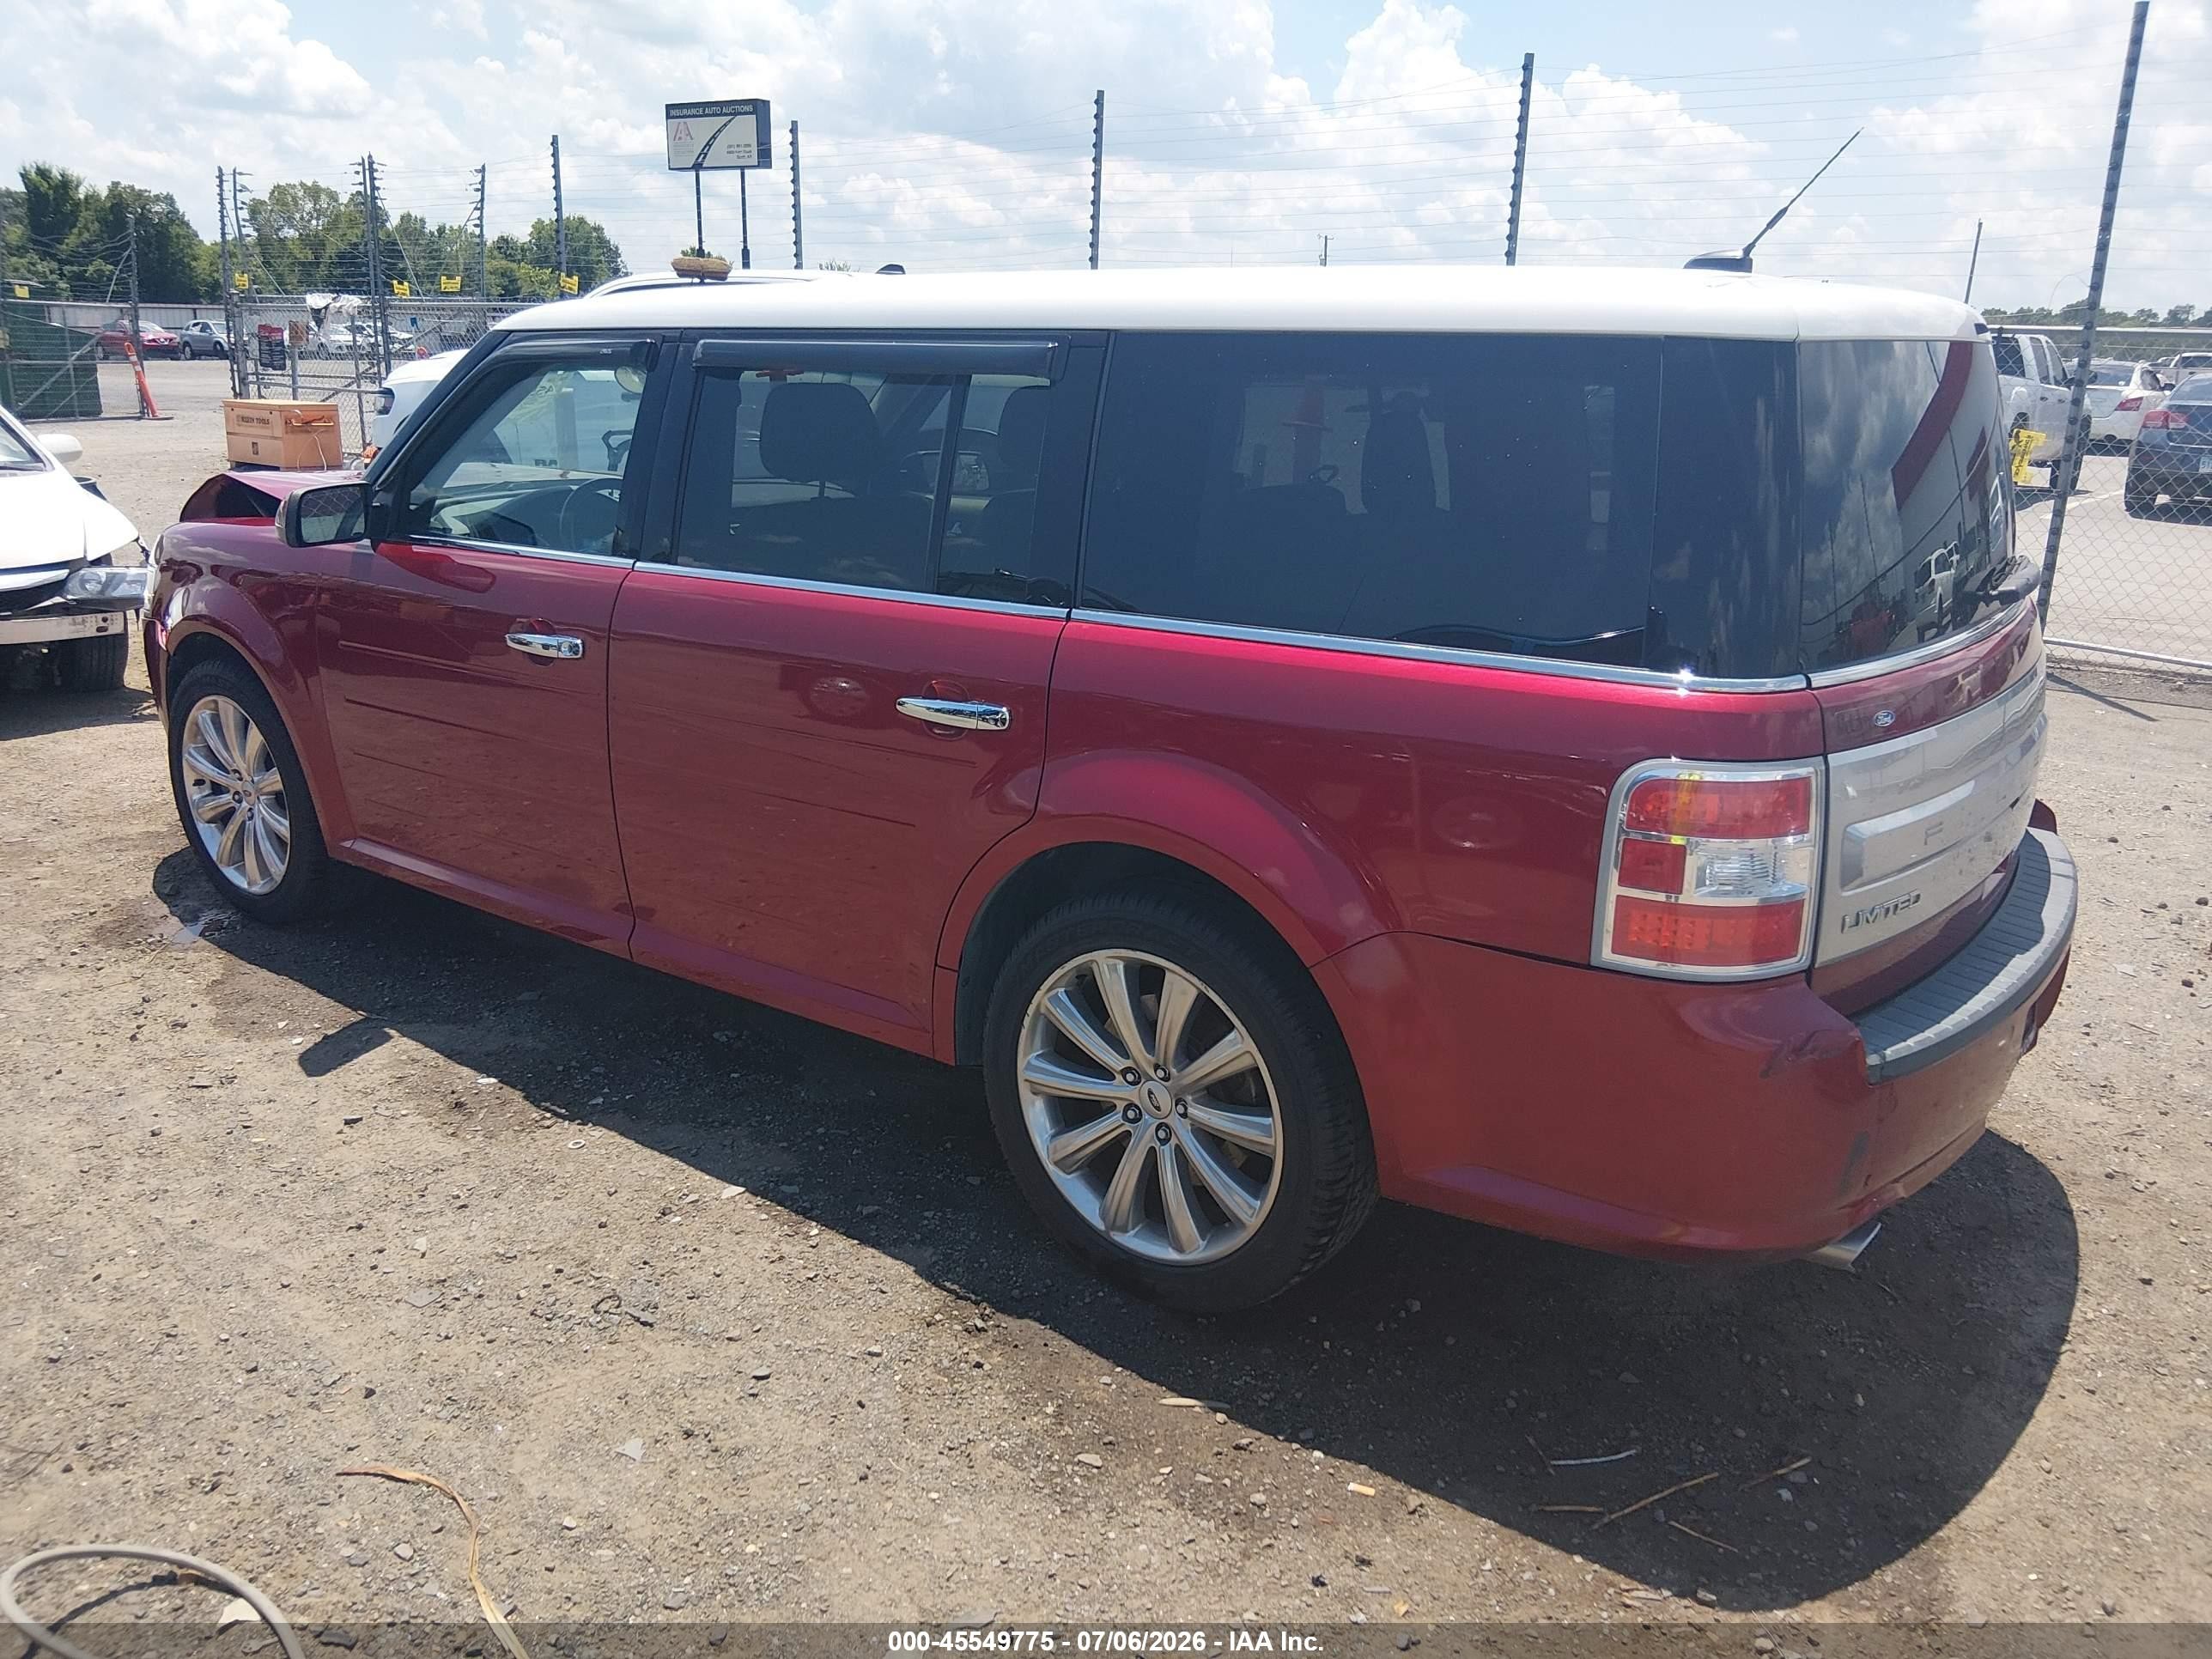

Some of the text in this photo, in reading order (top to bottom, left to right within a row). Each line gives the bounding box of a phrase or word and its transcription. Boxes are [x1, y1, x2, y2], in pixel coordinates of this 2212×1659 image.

[705, 106, 721, 115] AUTO
[722, 104, 754, 113] AUCTIONS
[255, 416, 270, 425] TOOLS
[1840, 889, 1921, 934] LIMITED
